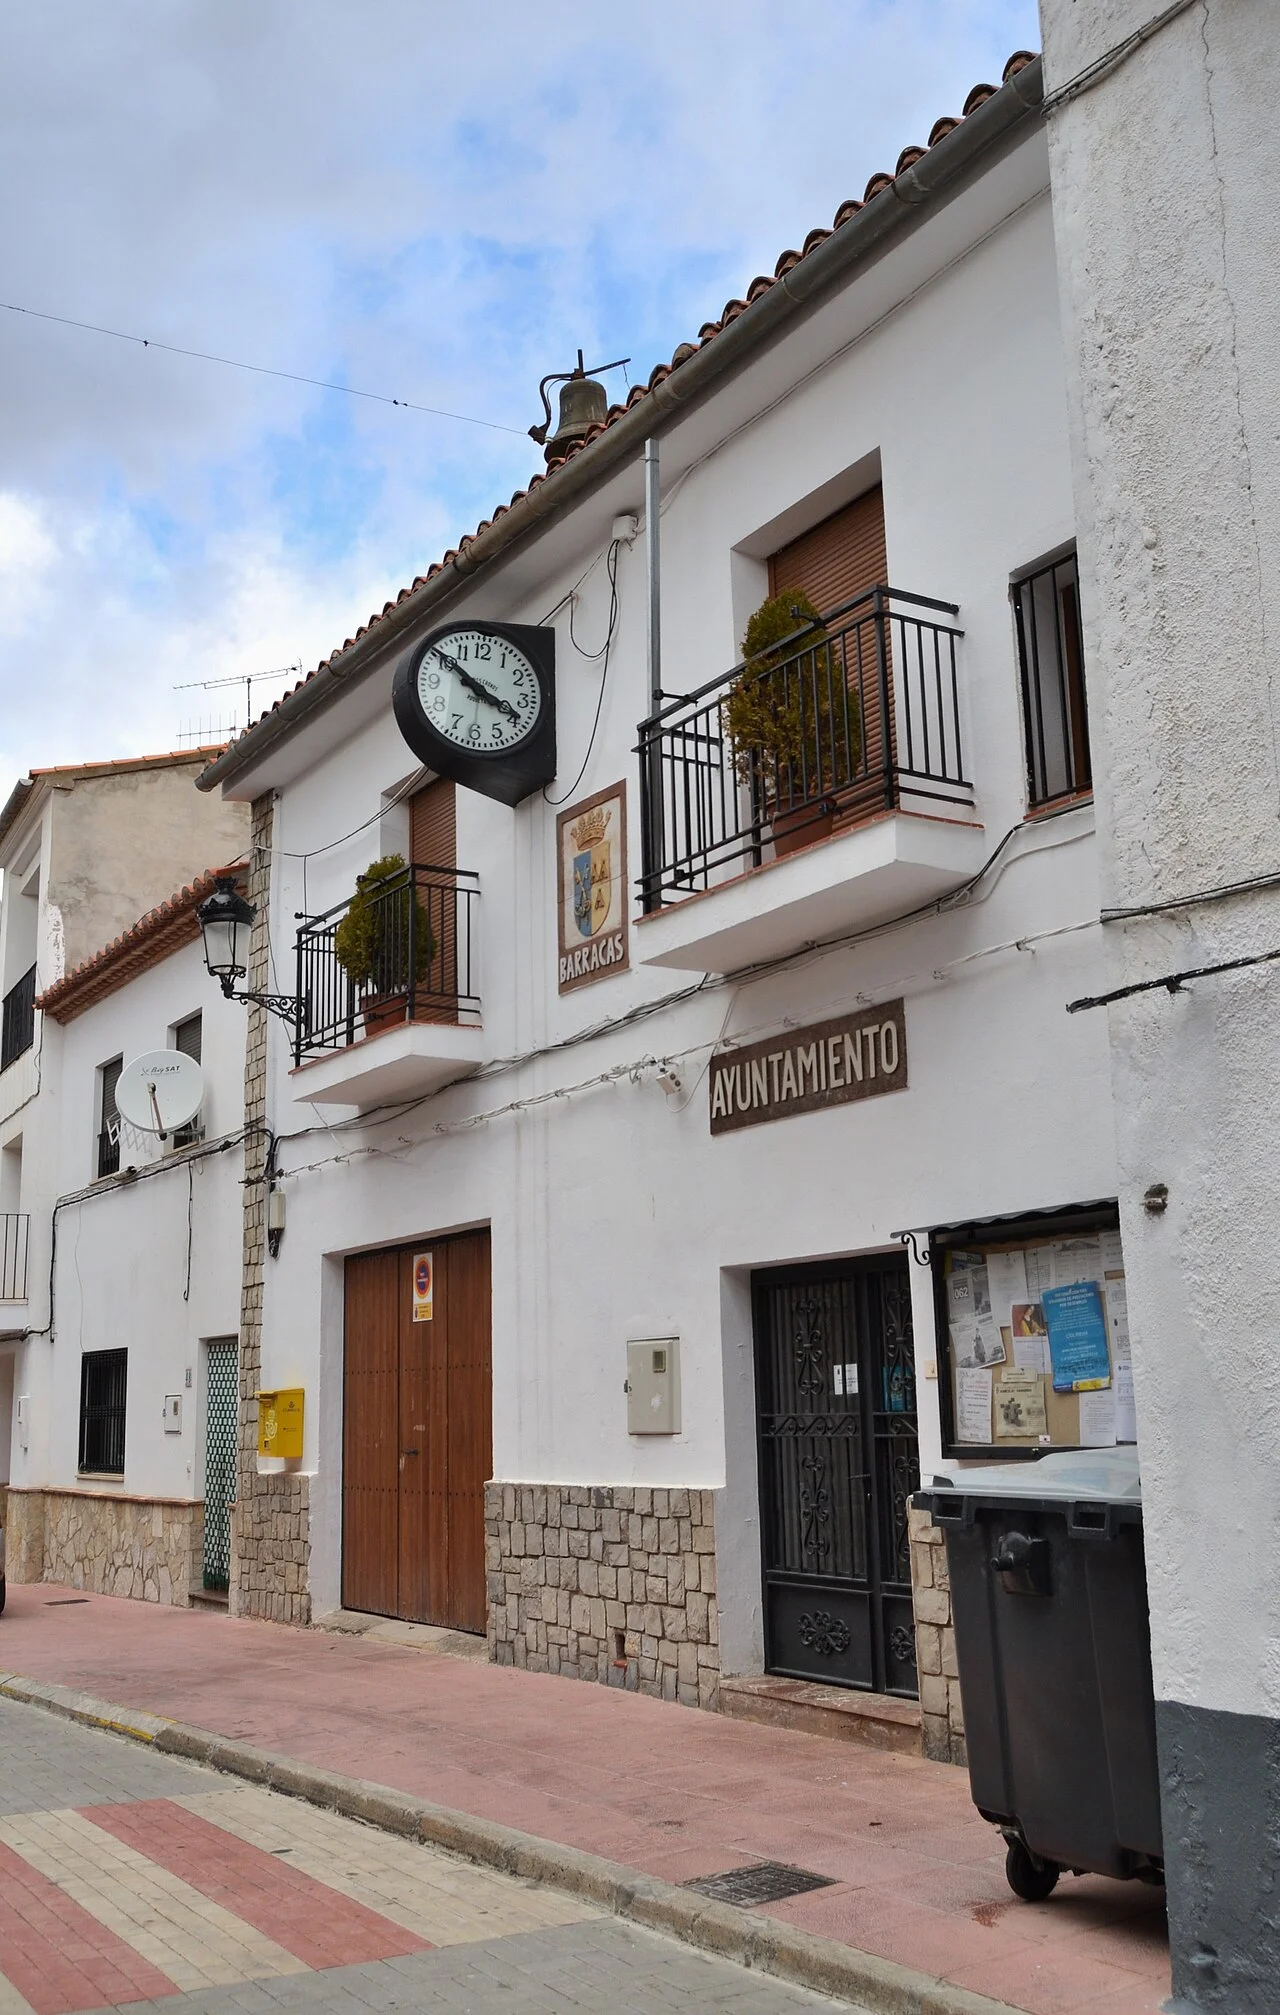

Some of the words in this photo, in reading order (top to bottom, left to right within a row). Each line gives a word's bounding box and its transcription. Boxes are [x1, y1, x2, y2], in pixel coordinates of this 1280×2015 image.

[457, 643, 468, 661] 11
[474, 642, 492, 661] 12
[500, 652, 506, 669] 1
[428, 673, 440, 690] 9
[512, 669, 524, 687] 2
[433, 696, 445, 712] 8
[516, 692, 529, 709] 3
[451, 713, 464, 730] 7
[468, 723, 481, 740] 6
[491, 722, 503, 739] 5
[559, 932, 625, 984] BARRACAS
[711, 1019, 899, 1119] AYUNTAMIENTO
